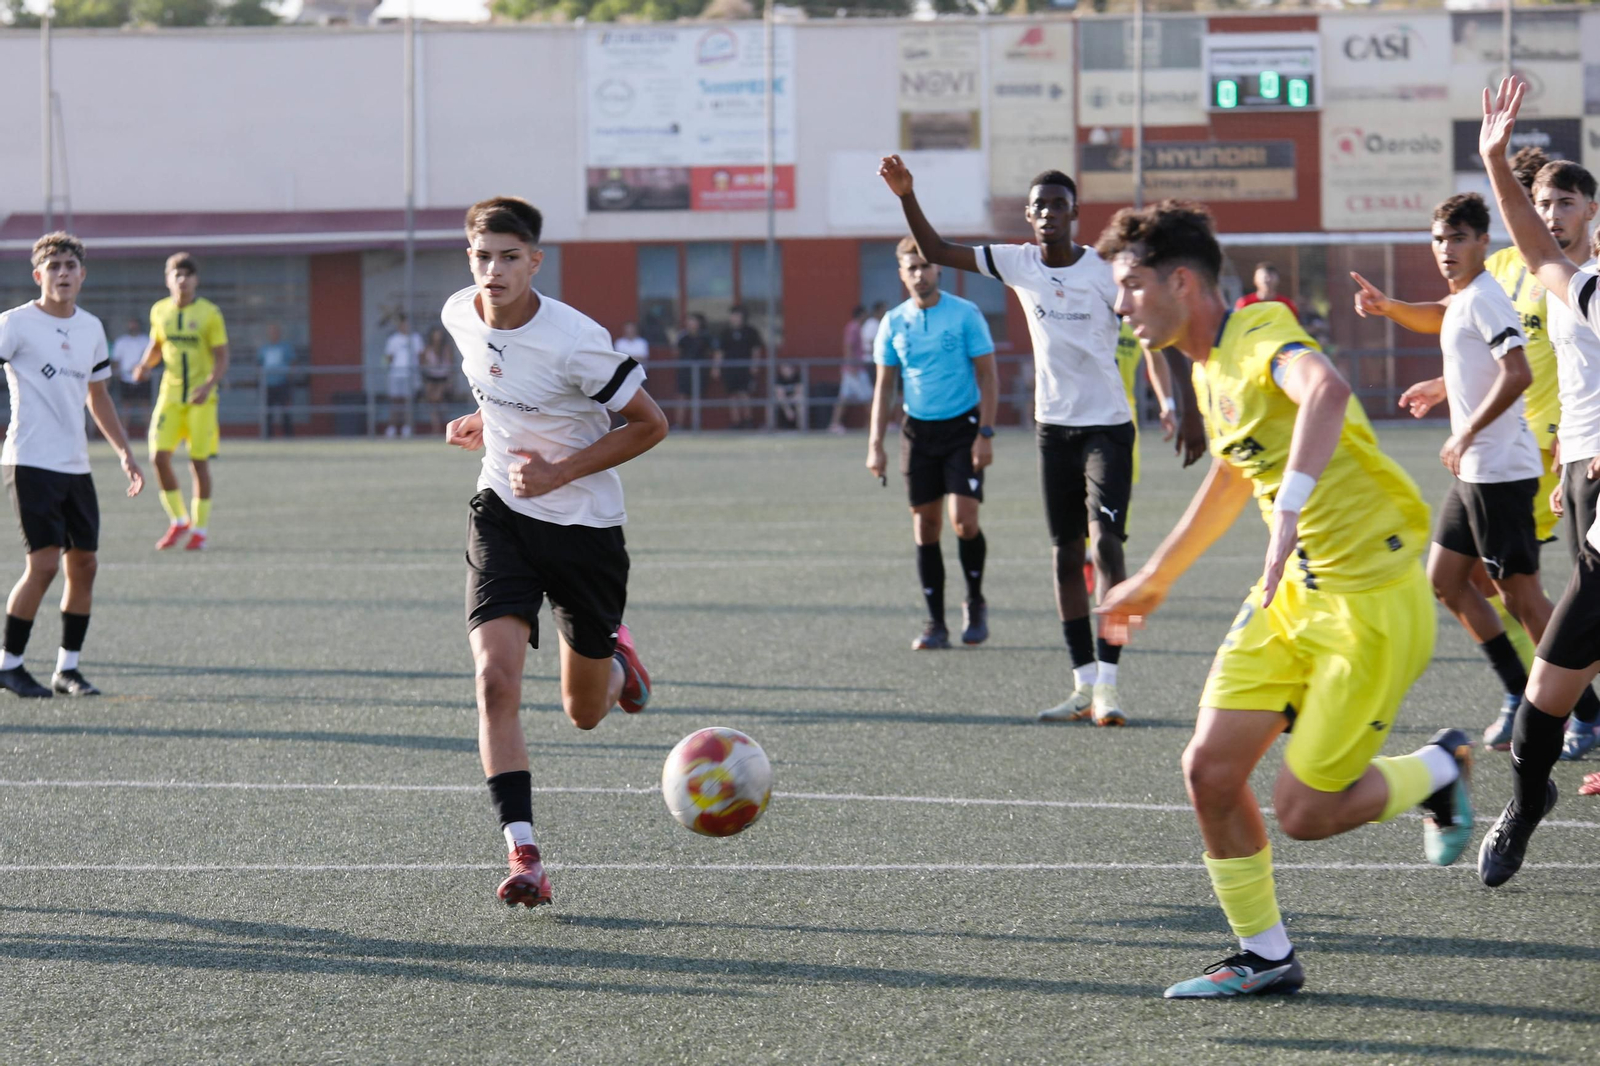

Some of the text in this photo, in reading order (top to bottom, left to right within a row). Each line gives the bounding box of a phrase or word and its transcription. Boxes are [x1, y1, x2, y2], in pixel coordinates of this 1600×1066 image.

[901, 70, 977, 94] NOVI
[1217, 80, 1238, 108] 0
[1288, 79, 1308, 107] 0
[1156, 146, 1267, 167] HYUNDAI
